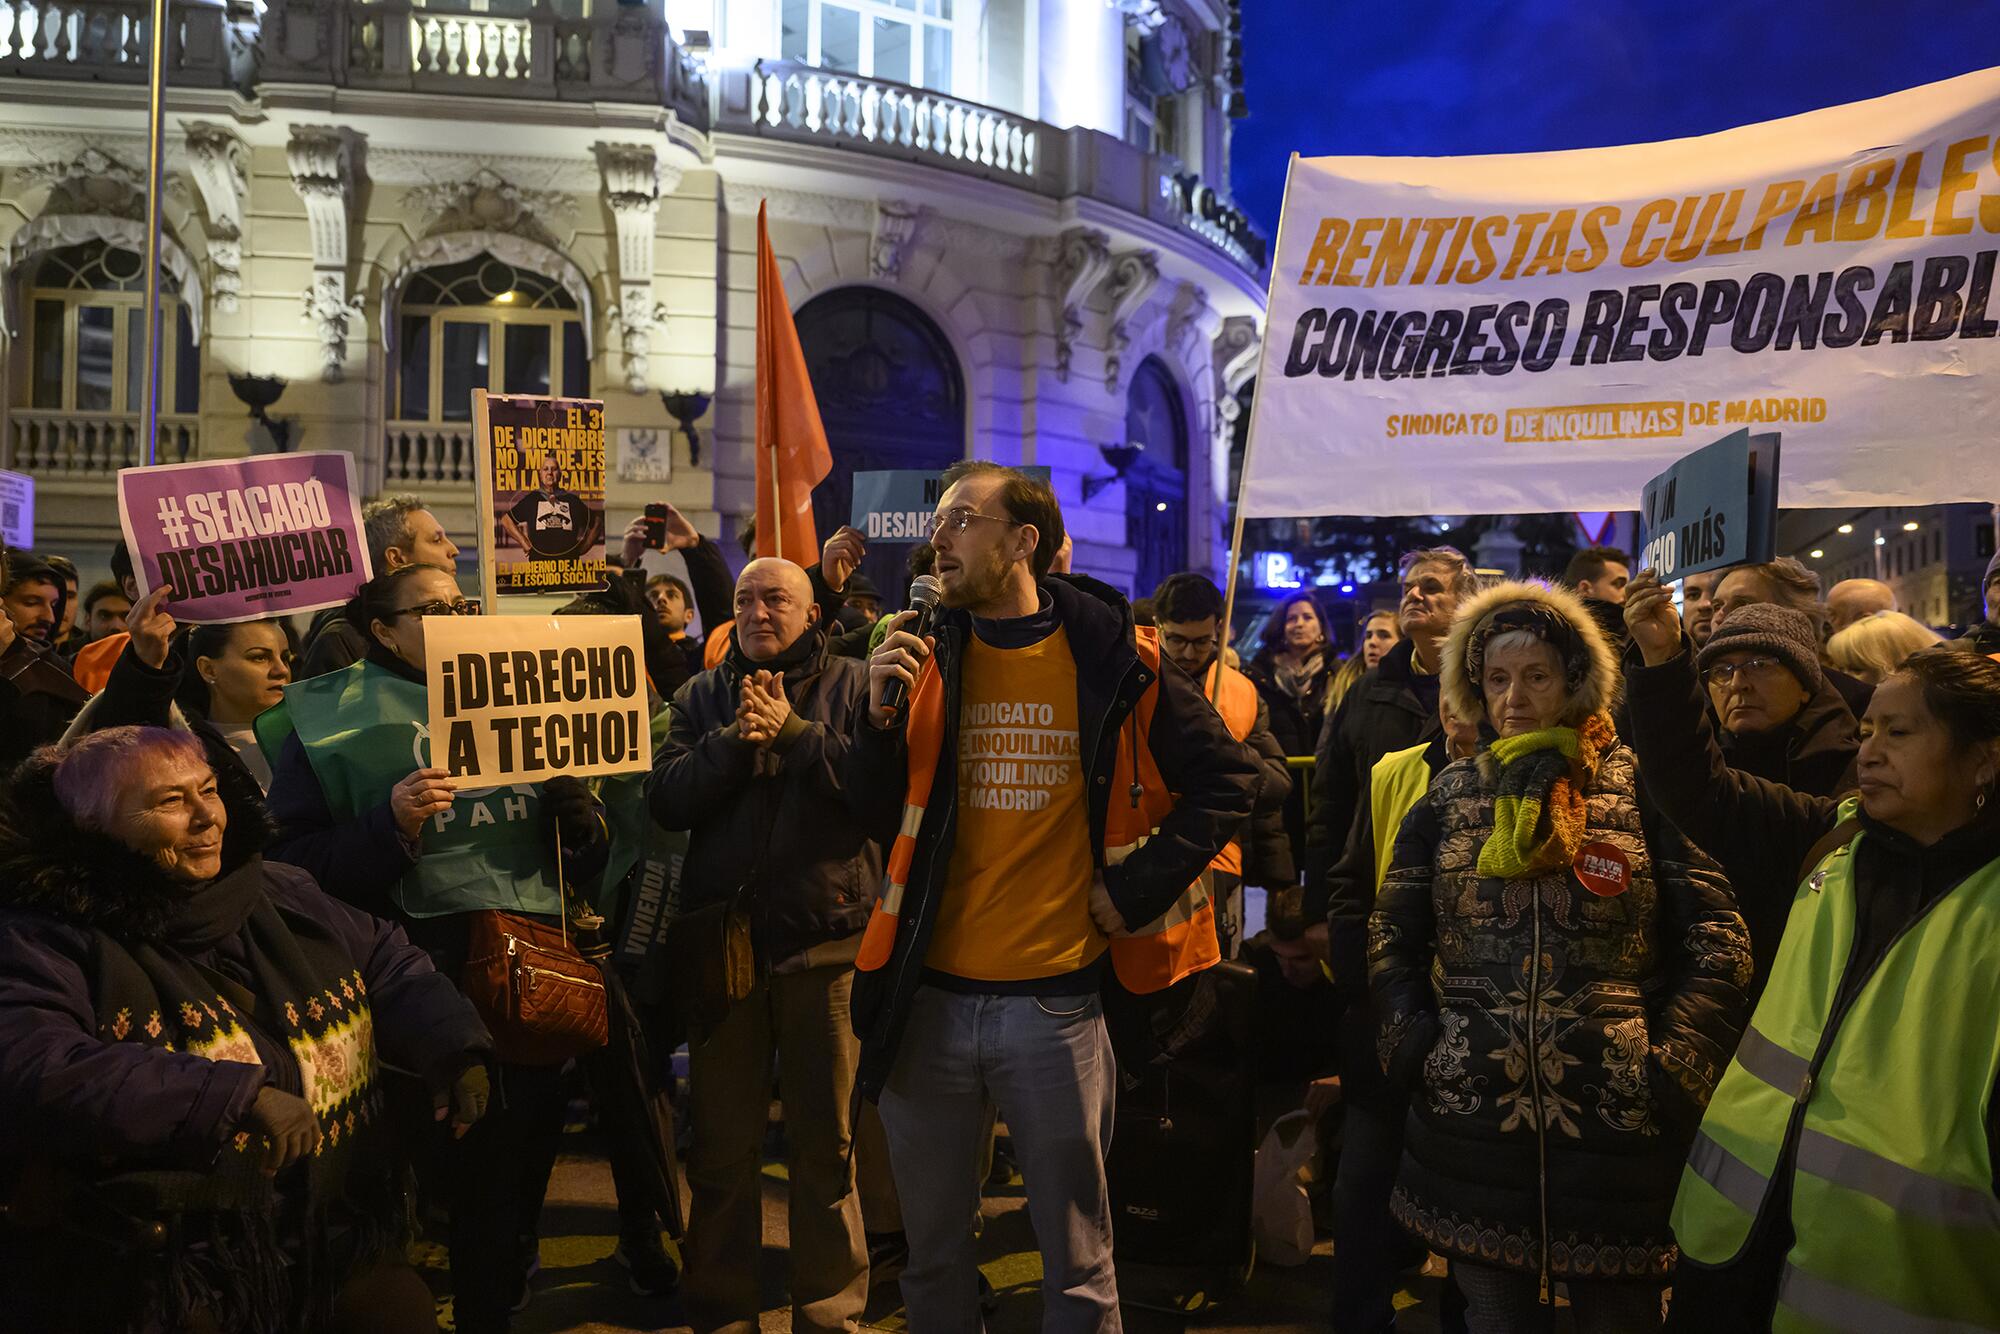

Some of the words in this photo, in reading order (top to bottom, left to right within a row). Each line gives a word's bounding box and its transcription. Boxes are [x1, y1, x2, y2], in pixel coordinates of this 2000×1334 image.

[1298, 205, 1622, 288] RENTISTAS
[1284, 297, 1569, 381] CONGRESO
[1570, 250, 2000, 366] RESPONSABL
[567, 407, 585, 429] EL
[1386, 412, 1499, 438] SINDICATO
[1510, 409, 1537, 438] DE
[1541, 406, 1679, 436] INQUILINAS
[1689, 400, 1720, 426] DE
[1724, 396, 1827, 423] MADRID
[494, 425, 515, 448] DE
[521, 426, 605, 450] DICIEMBRE
[495, 447, 519, 470] NO
[556, 449, 605, 471] DEJES
[496, 469, 517, 491] EN
[520, 469, 540, 491] LA
[558, 470, 605, 491] CALLE
[157, 475, 331, 548] #SEACABÓ
[868, 511, 935, 538] DESAH
[1681, 505, 1726, 569] MÁS
[157, 528, 353, 603] DESAHUCIAR
[511, 560, 556, 574] GOBIERNO
[558, 559, 584, 573] DEJA
[511, 574, 523, 587] EL
[525, 572, 561, 586] ESCUDO
[562, 569, 599, 584] SOCIAL
[442, 645, 637, 718] ¡DERECHO
[960, 702, 1054, 726] INDICATO
[448, 720, 481, 778] A
[490, 710, 639, 774] TECHO!
[434, 795, 527, 833] PAH
[969, 788, 1050, 811] MADRID
[624, 859, 666, 955] VIVIENDA
